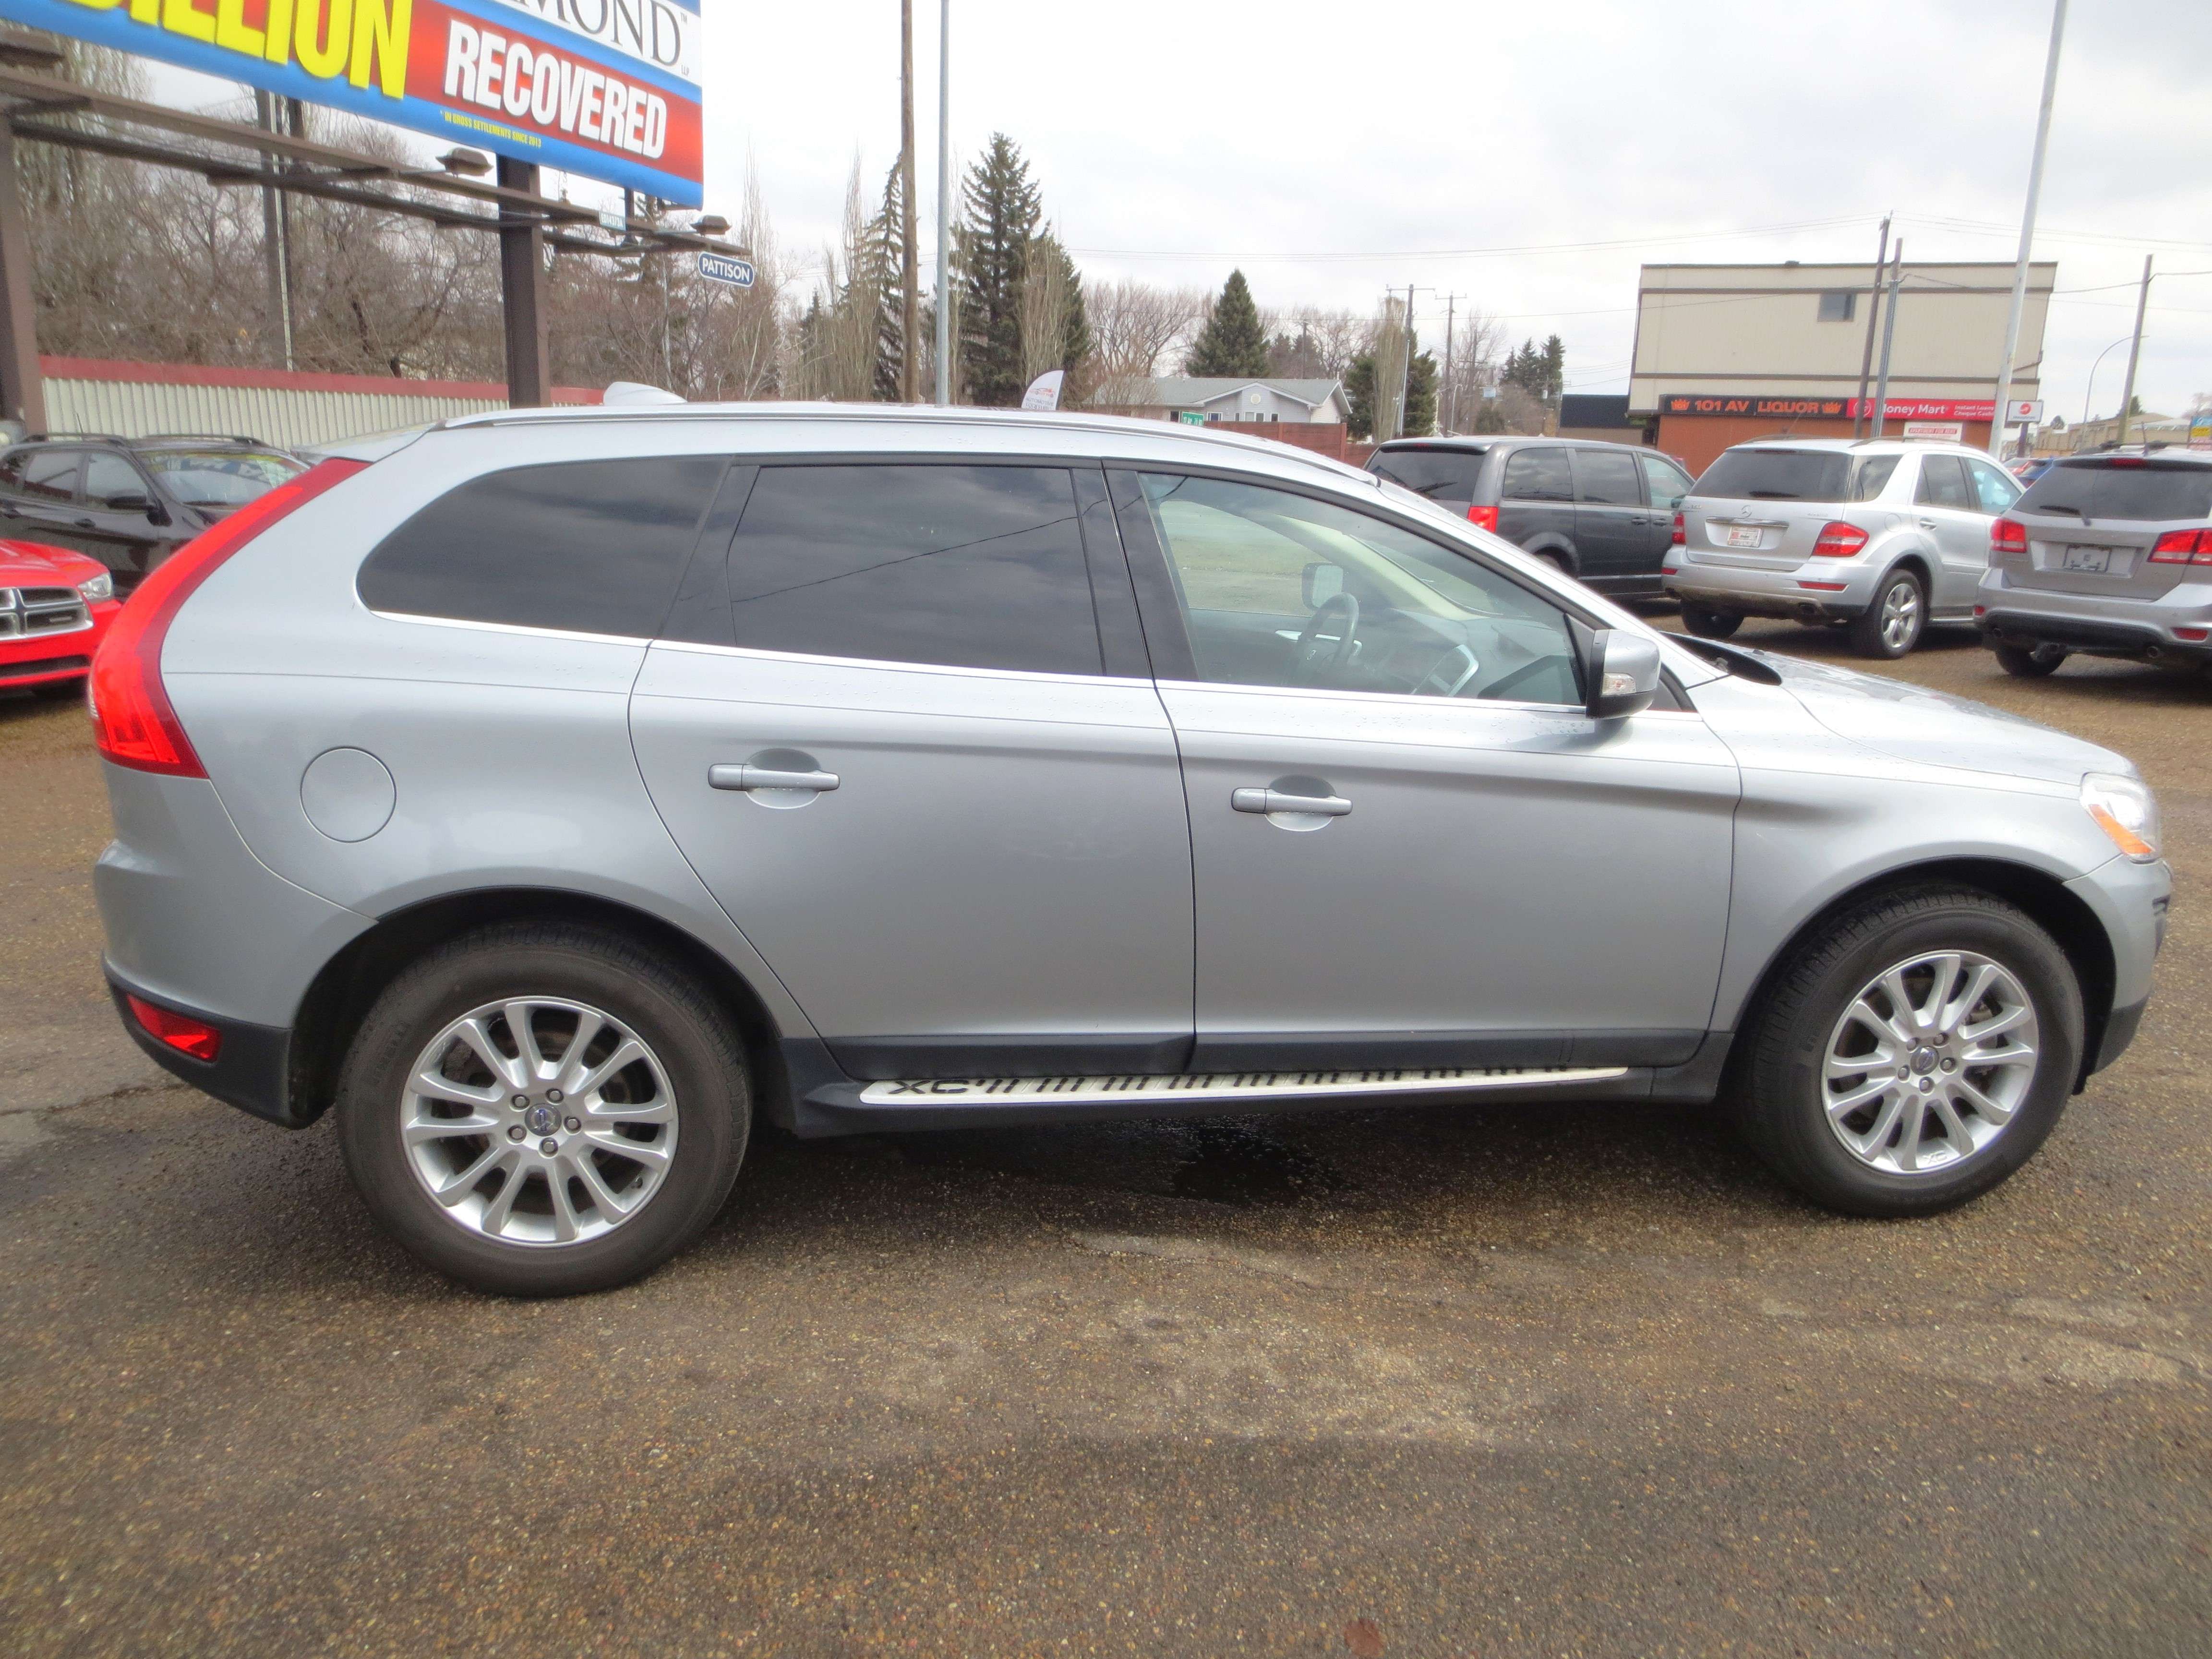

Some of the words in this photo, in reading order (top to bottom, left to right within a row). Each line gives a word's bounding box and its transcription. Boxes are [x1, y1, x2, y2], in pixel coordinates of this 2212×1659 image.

[520, 0, 681, 66] OND
[62, 0, 412, 99] LLION
[445, 19, 667, 159] RECOVERED
[453, 113, 472, 128] GROSS
[473, 120, 511, 139] SETTLEMENTS
[512, 131, 528, 145] SINCE
[702, 257, 750, 282] PATTISON
[1695, 400, 1721, 411] 101
[1725, 400, 1750, 411] AV
[1757, 401, 1819, 413] LIQUOR
[1918, 404, 1946, 414] Mart
